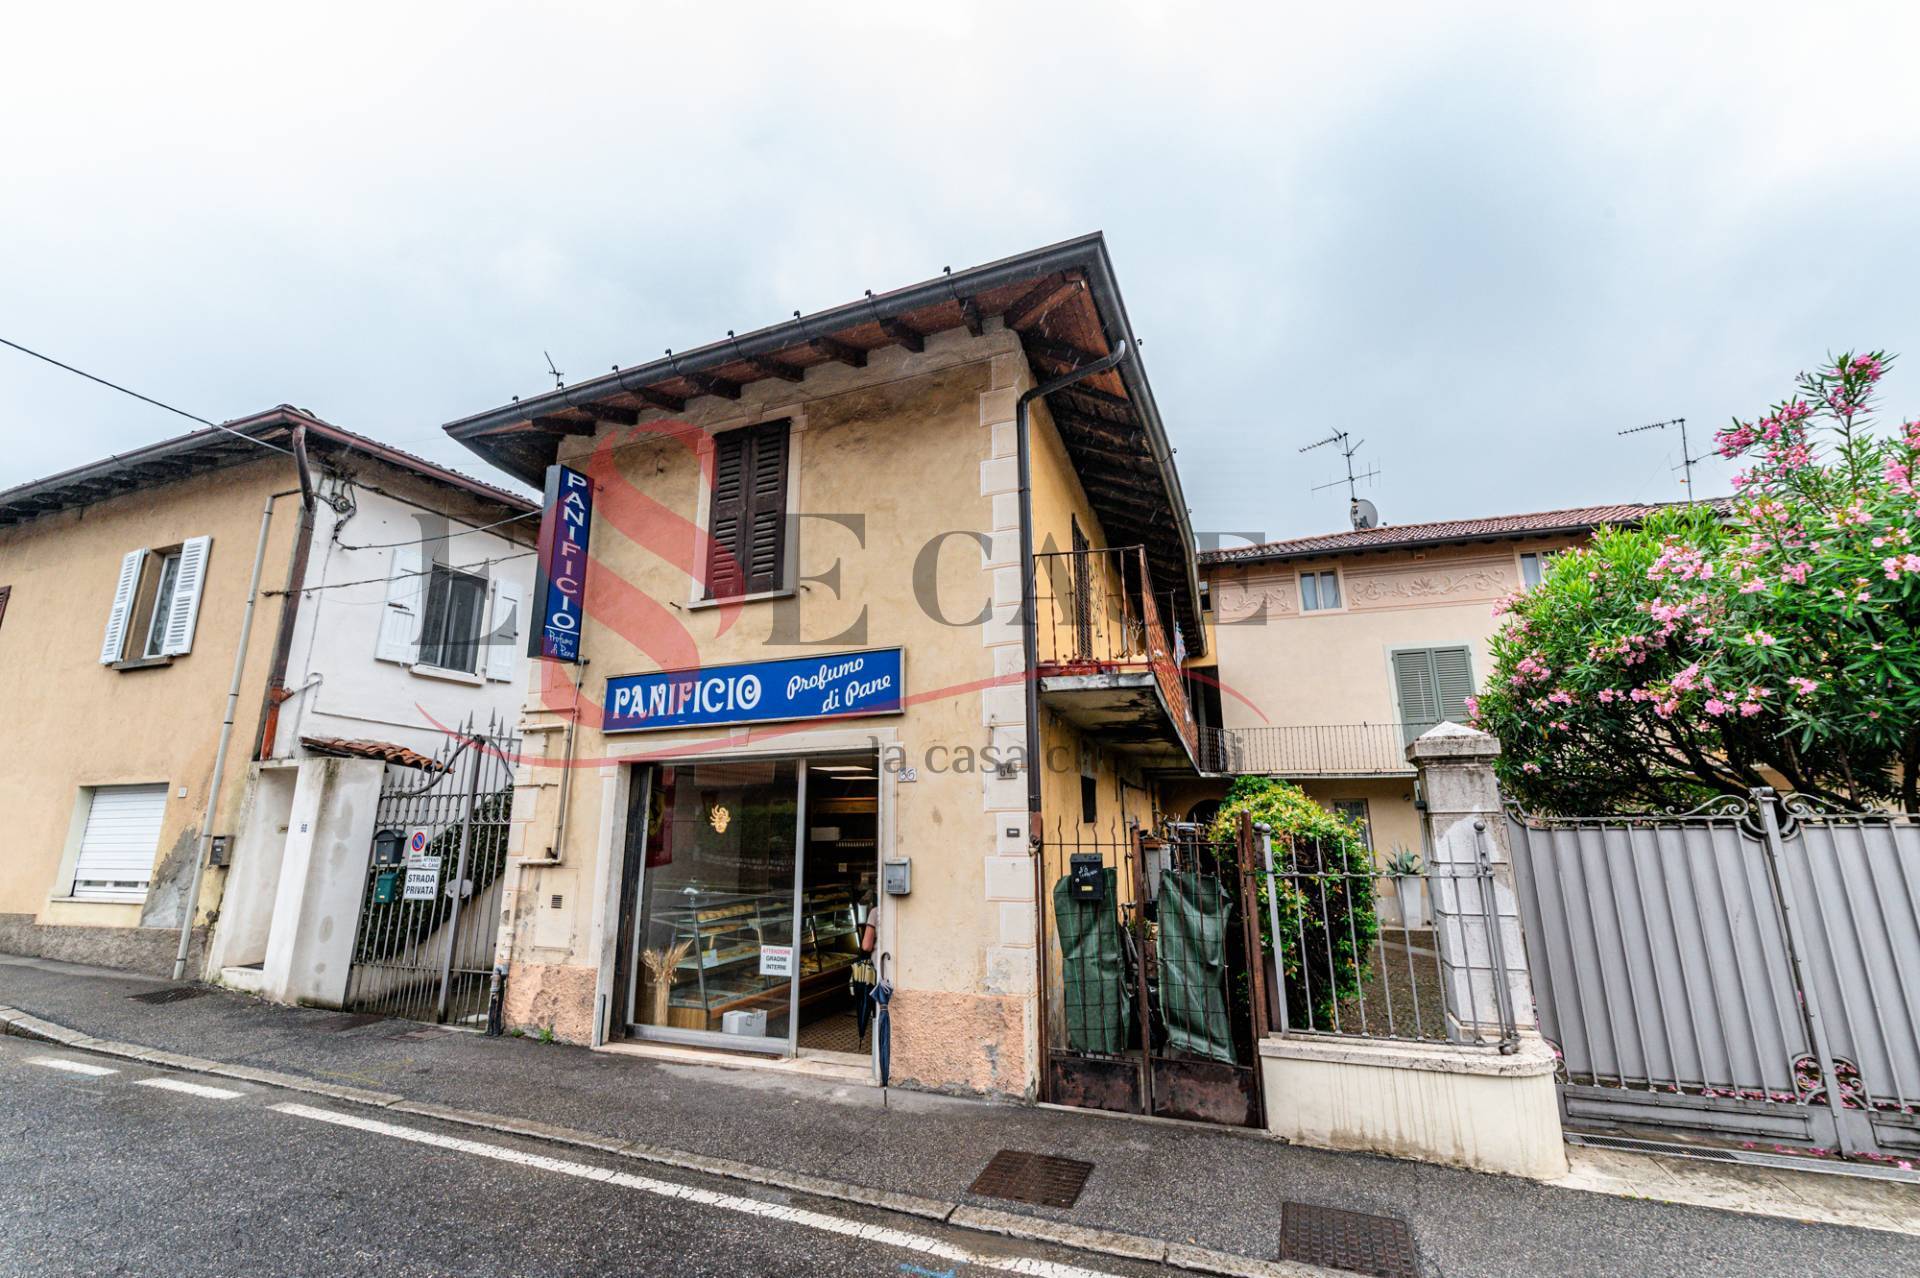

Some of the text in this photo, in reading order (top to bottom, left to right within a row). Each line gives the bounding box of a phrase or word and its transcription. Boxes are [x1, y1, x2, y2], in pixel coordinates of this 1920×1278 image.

[552, 471, 587, 629] PANIFICIO
[549, 629, 573, 646] Profumo
[560, 645, 575, 658] Pane
[612, 657, 864, 720] PANIFICIO Profumo
[821, 674, 891, 713] di Pane
[407, 874, 435, 883] STRADA
[405, 886, 434, 895] PRIVATA
